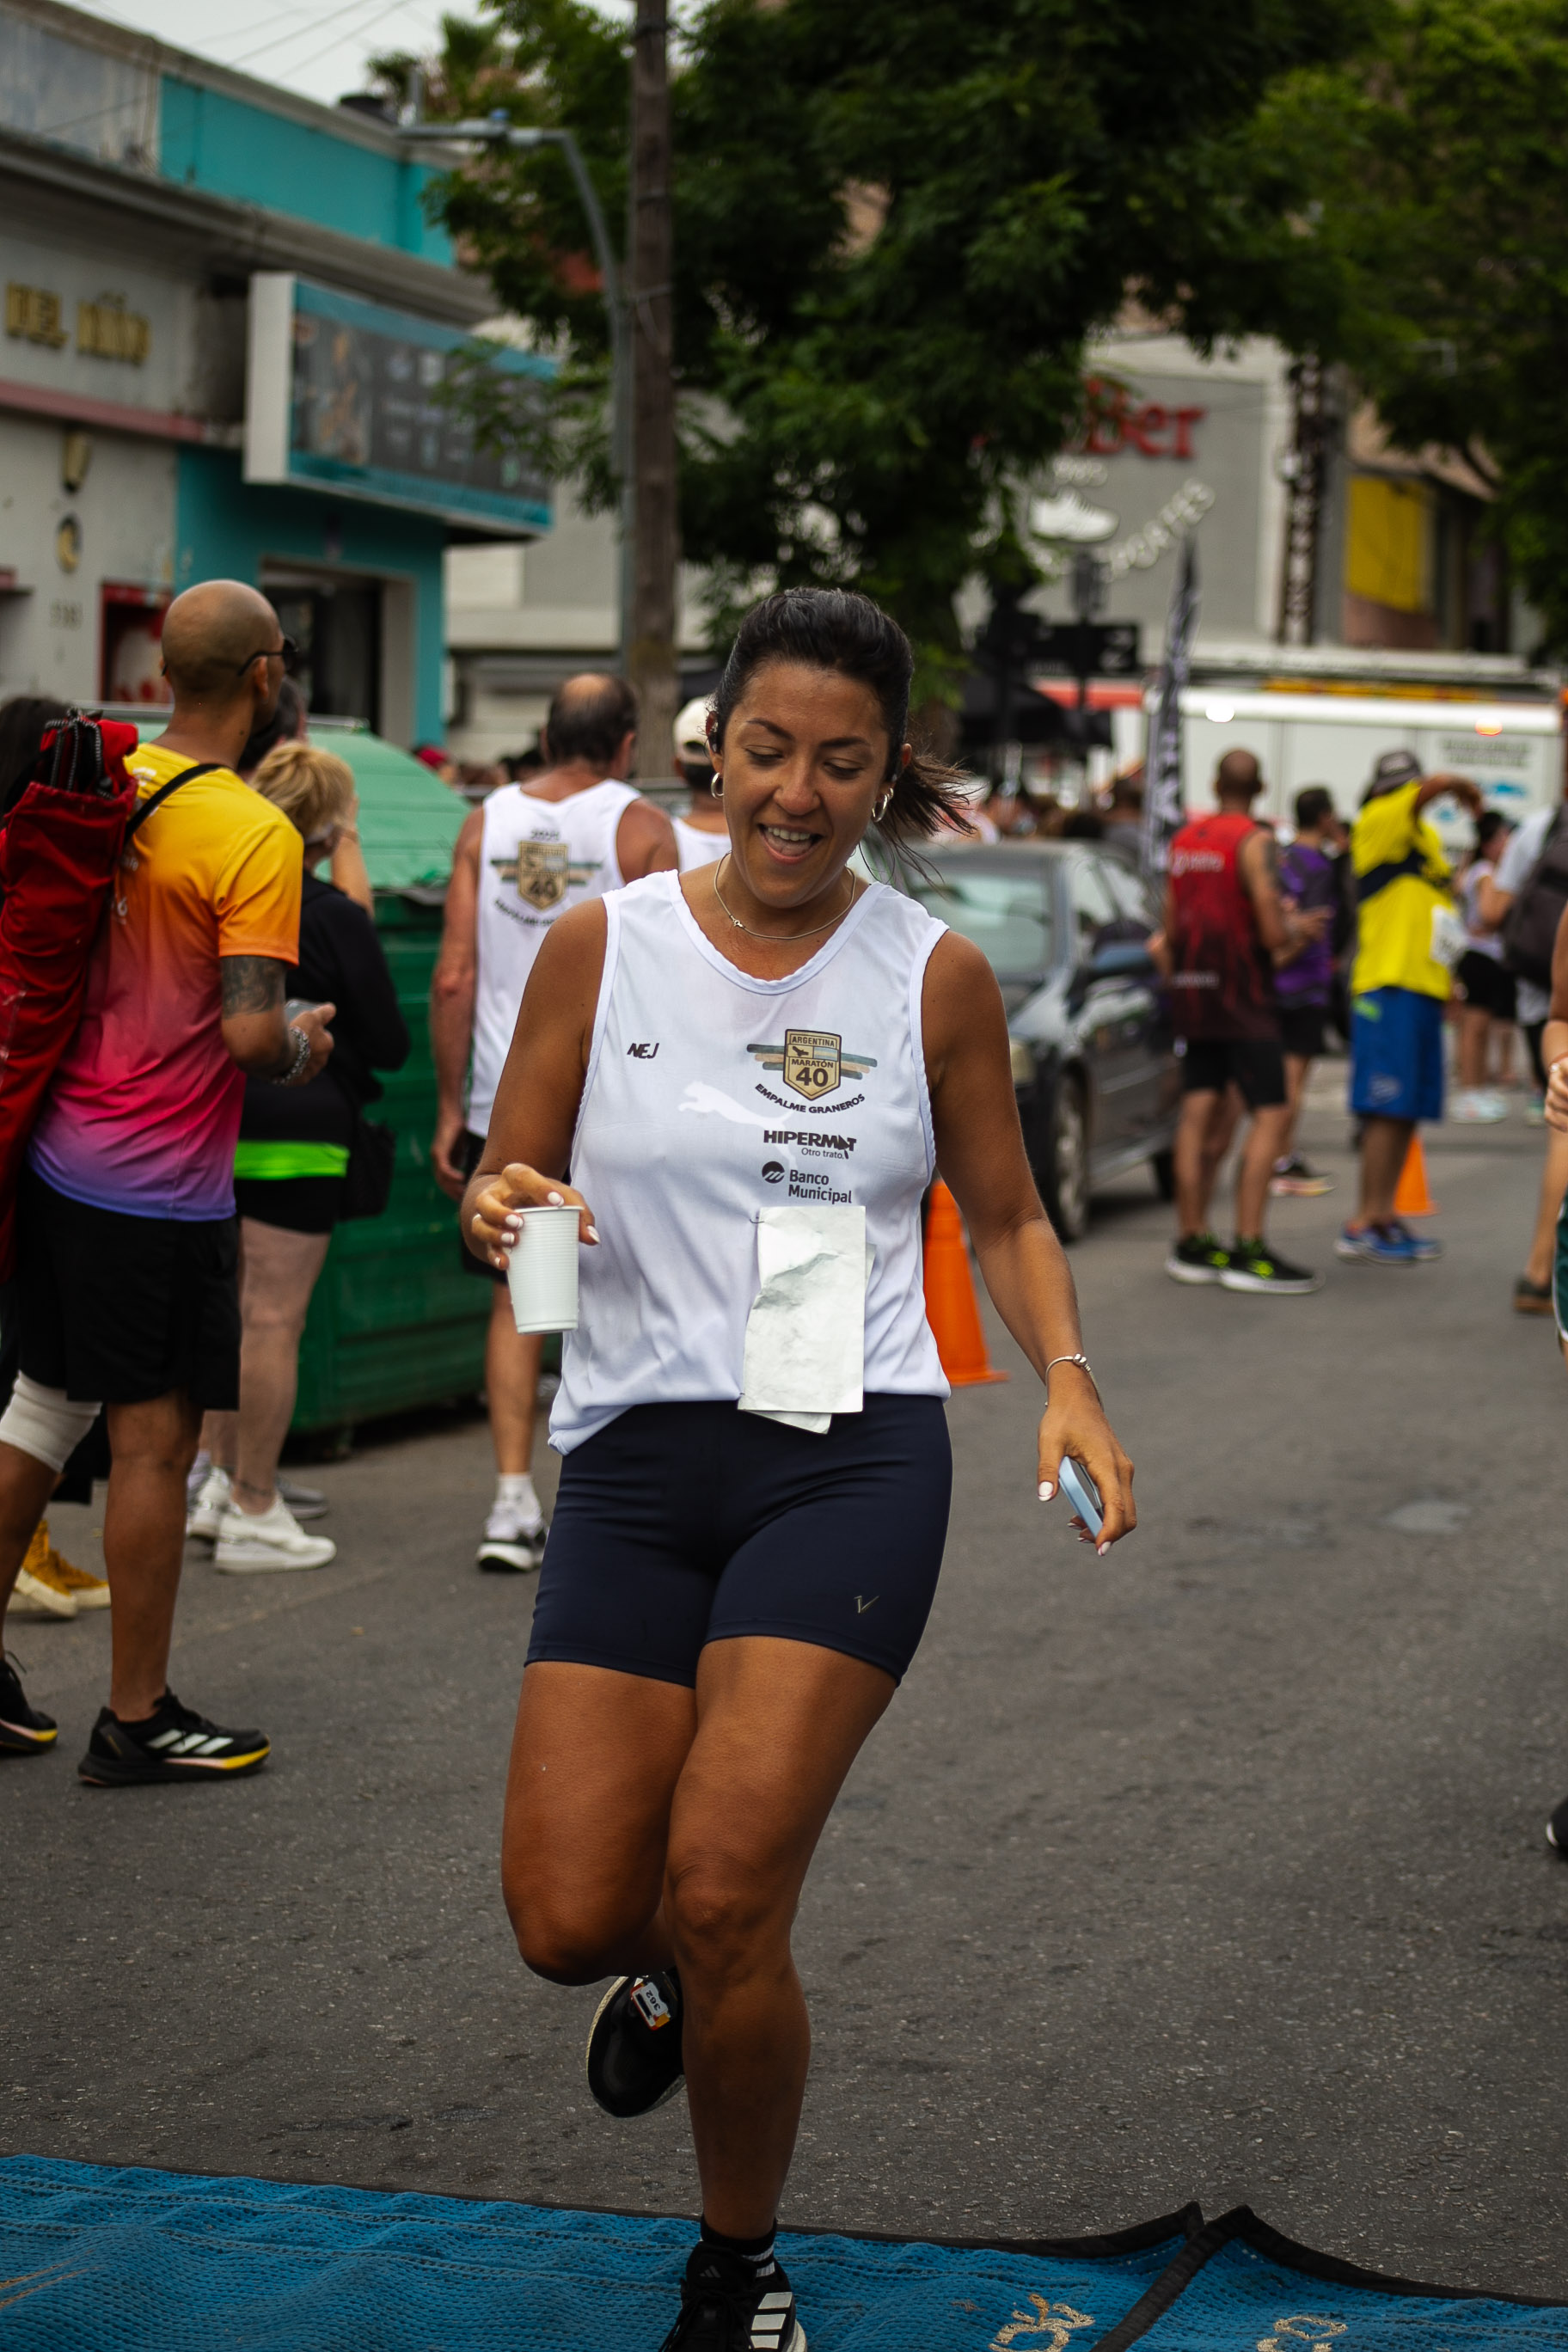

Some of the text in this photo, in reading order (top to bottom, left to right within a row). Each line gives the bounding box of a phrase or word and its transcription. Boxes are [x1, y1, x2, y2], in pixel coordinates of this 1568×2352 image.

[792, 1036, 835, 1047] ARGENTINA
[627, 1043, 659, 1059] NEJ
[791, 1058, 834, 1069] MARATÓN
[796, 1067, 829, 1087] 40
[755, 1083, 866, 1114] EMPALME GRANEROS
[801, 1148, 821, 1157] Otro
[789, 1169, 830, 1185] Banco
[788, 1184, 852, 1204] Municipal
[646, 1990, 661, 2011] 362
